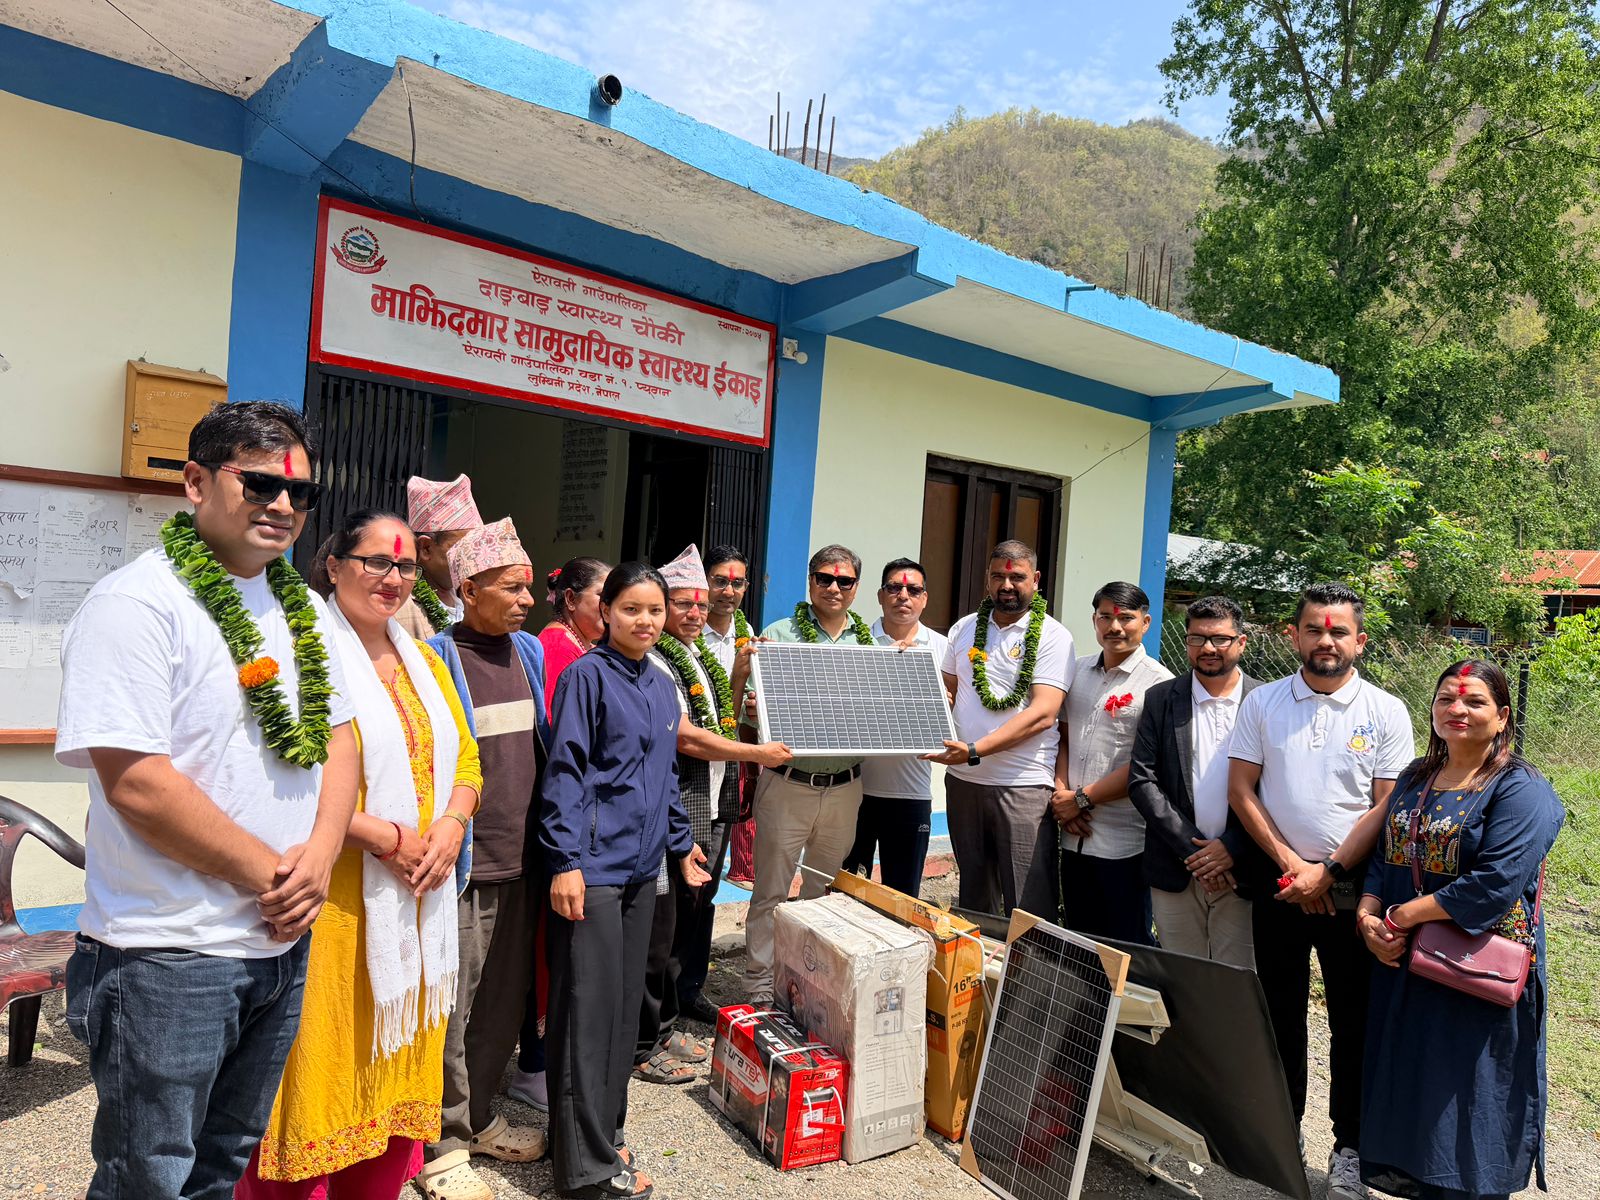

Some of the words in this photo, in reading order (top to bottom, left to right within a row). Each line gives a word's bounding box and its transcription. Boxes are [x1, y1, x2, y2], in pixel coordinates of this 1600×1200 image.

[531, 267, 577, 293] ऐरावती
[582, 284, 648, 312] गाउँपालिका
[557, 299, 624, 329] स्वास्थ्य
[462, 341, 507, 362] ऐरावती
[511, 354, 574, 376] गाउँपालिका
[578, 369, 603, 382] वडा
[514, 317, 634, 370] सामुदायिक
[638, 348, 710, 389] स्वास्थ्य
